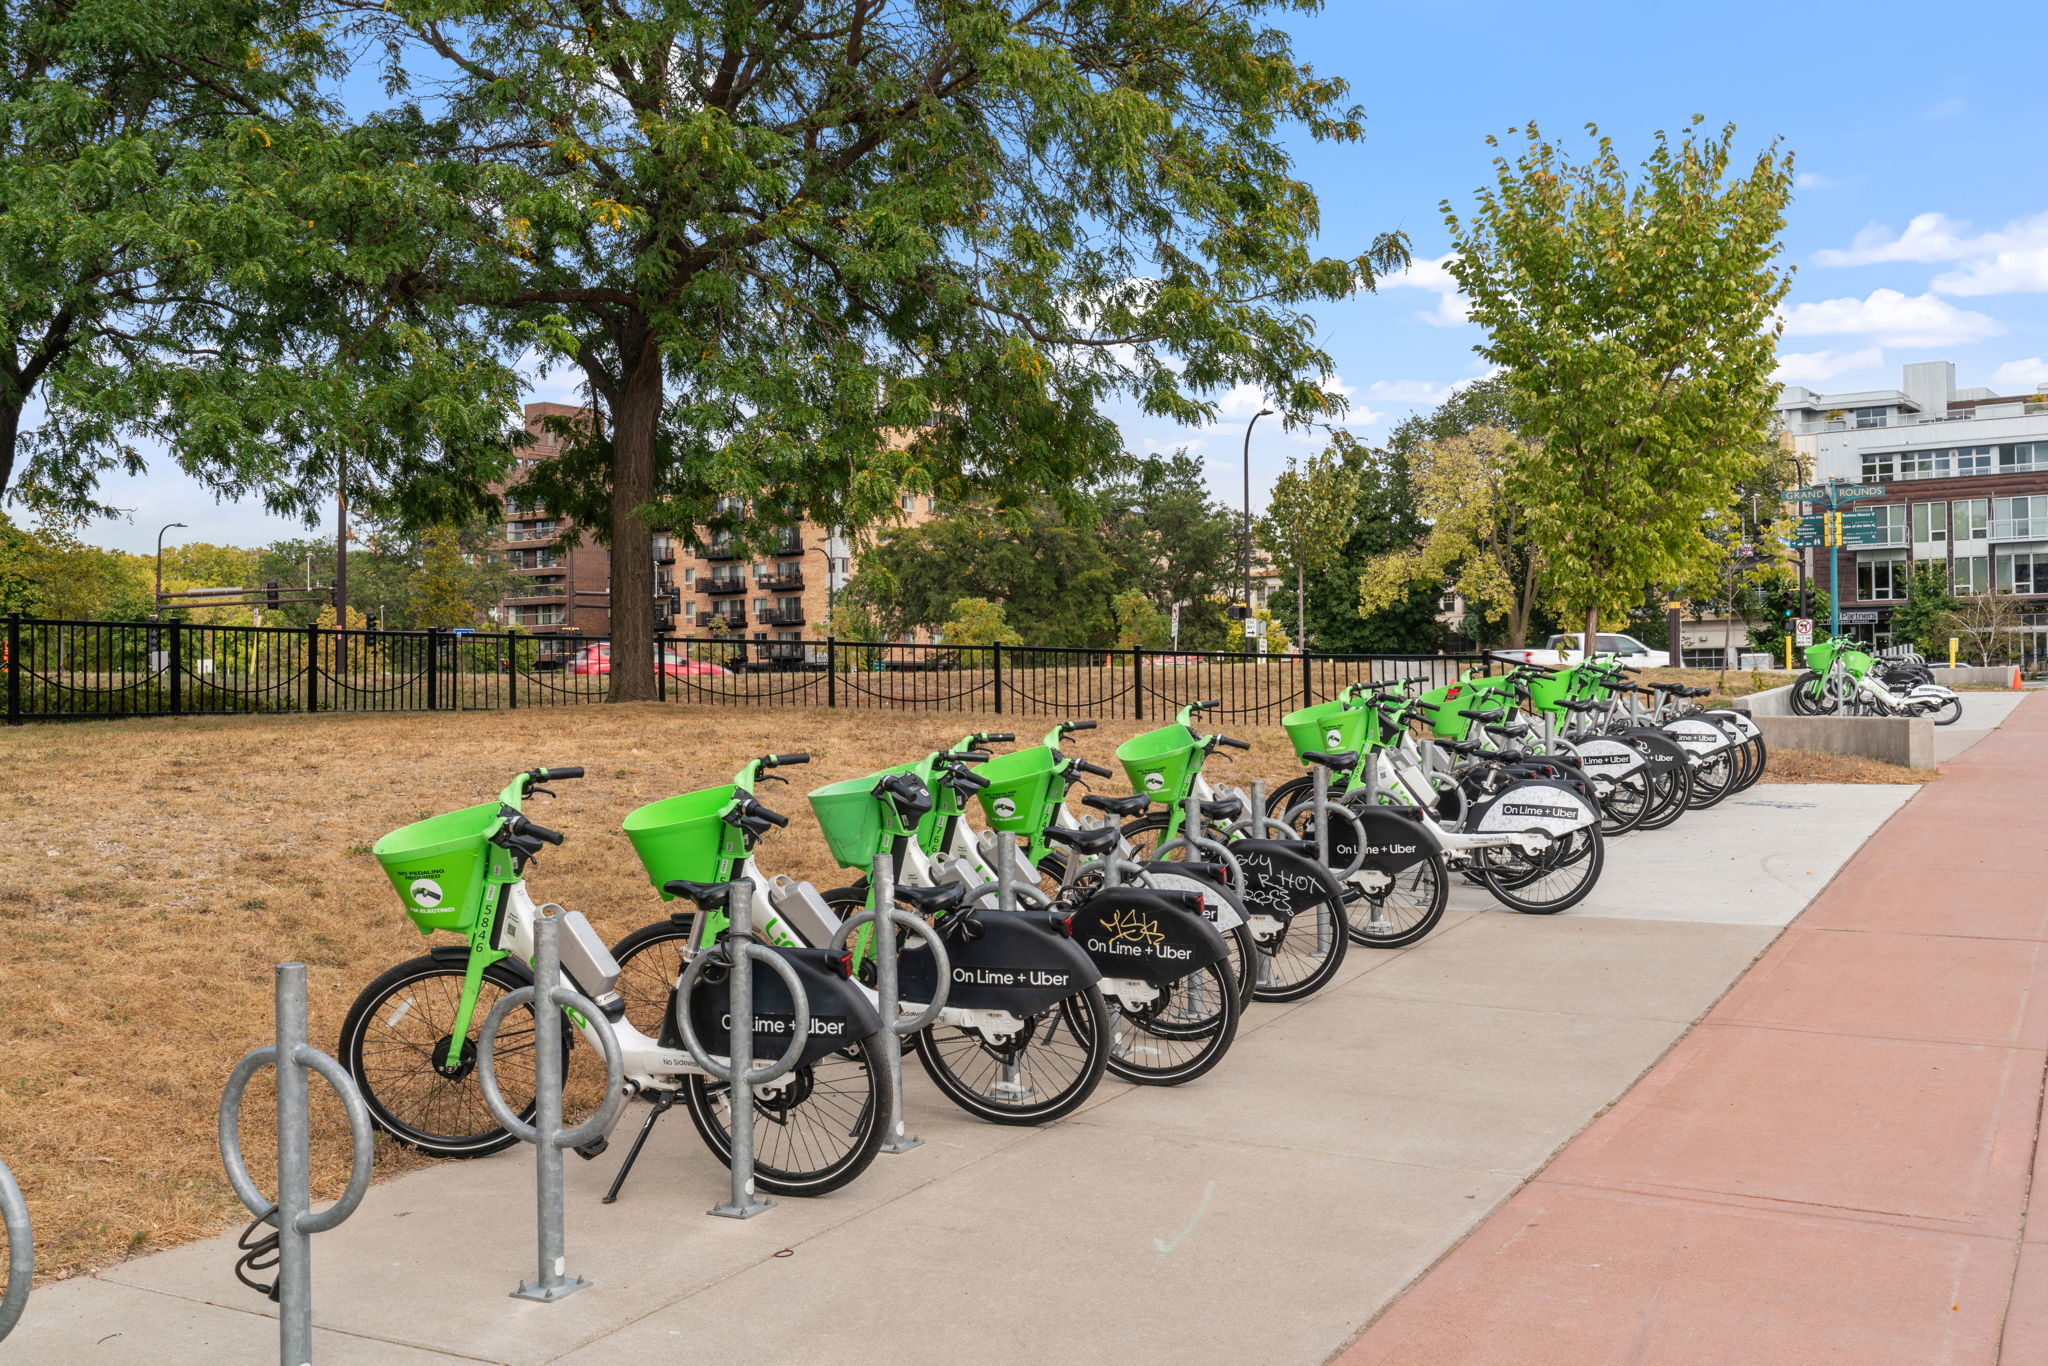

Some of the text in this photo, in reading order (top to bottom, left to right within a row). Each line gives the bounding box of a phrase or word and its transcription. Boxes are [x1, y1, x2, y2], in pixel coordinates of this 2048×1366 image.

[1785, 487, 1882, 500] GRAND ROUNDS
[1841, 611, 1877, 620] Partners
[1584, 757, 1604, 765] Lime
[1610, 755, 1630, 763] Uber
[1655, 754, 1674, 762] Uber
[1503, 805, 1518, 815] On
[1519, 806, 1543, 815] Lime
[1552, 807, 1577, 818] Uber
[1336, 844, 1417, 855] On Lme + Uber
[408, 868, 445, 876] PEDALING
[1202, 910, 1216, 920] er
[475, 904, 492, 953] 5846
[1087, 938, 1192, 960] On Lime + Uber
[952, 967, 1069, 986] On Lime + Uber
[752, 1016, 785, 1033] ime
[788, 1021, 797, 1031] +
[662, 1058, 700, 1067] No Sidewa
